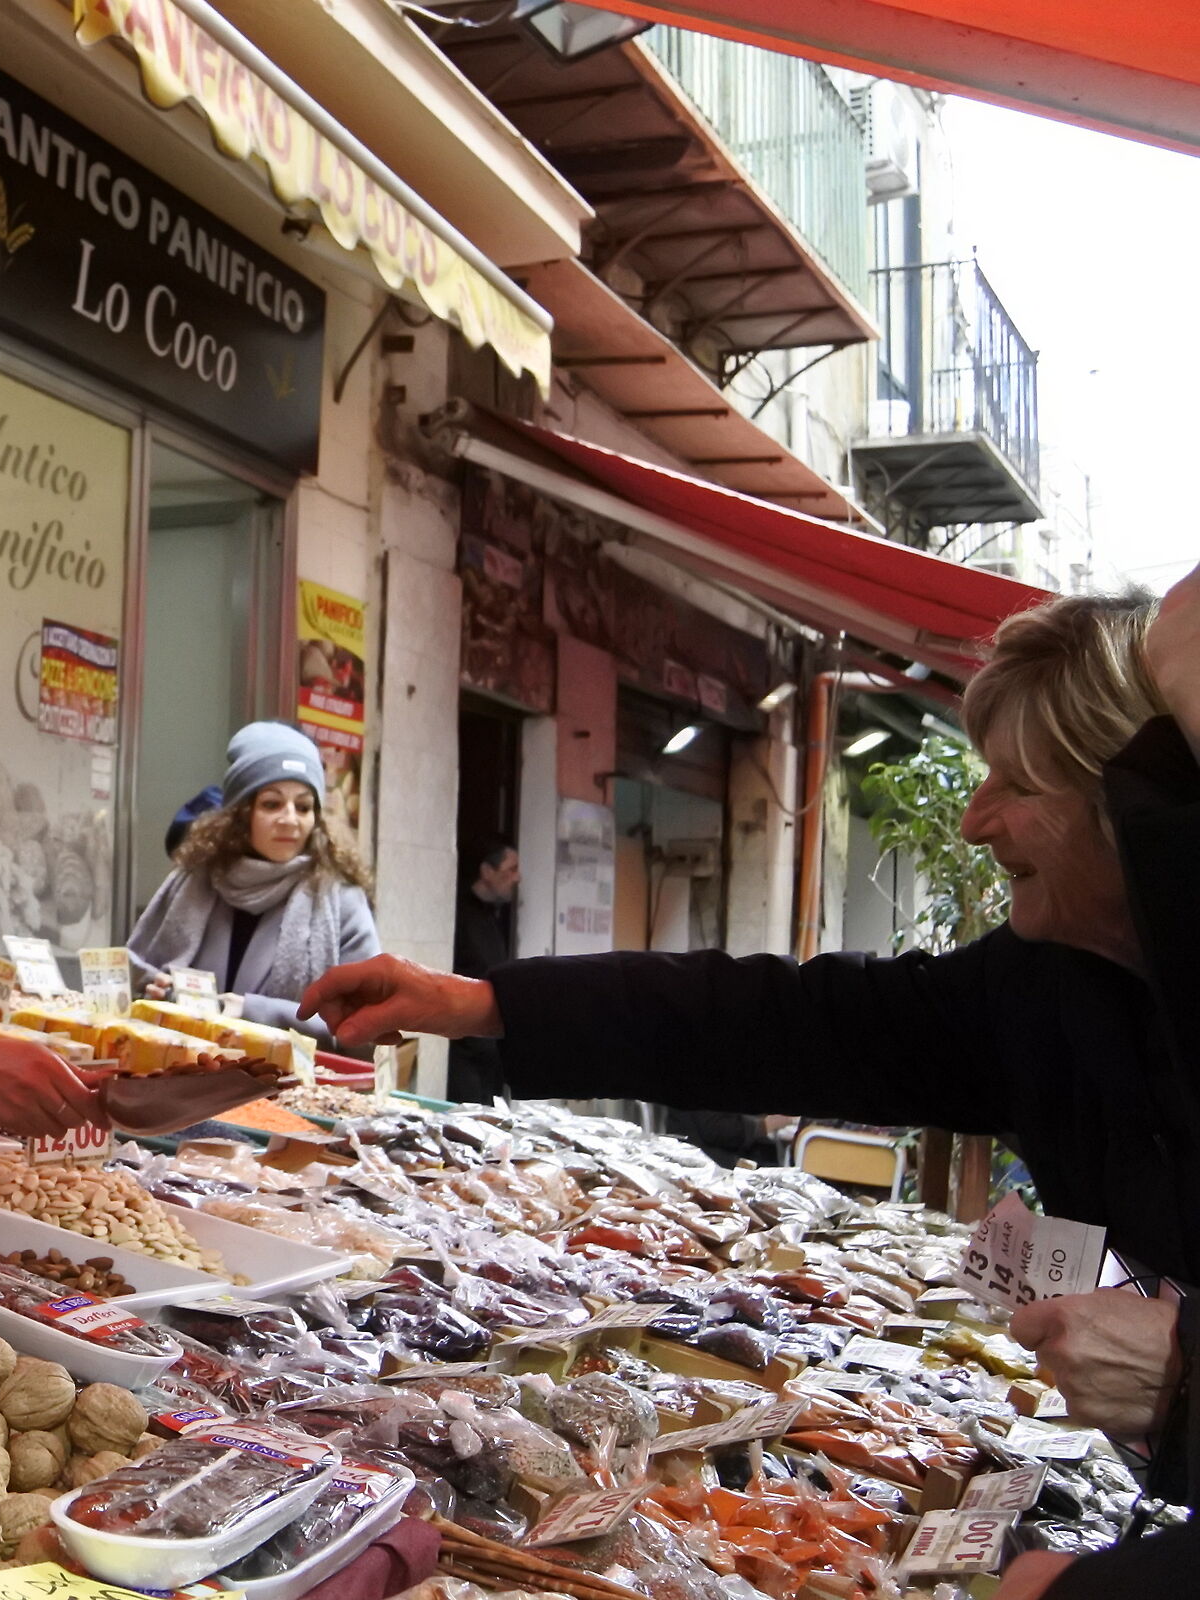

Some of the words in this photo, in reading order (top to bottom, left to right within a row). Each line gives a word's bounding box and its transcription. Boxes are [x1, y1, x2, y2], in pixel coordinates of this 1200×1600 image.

[149, 197, 305, 333] PANIFICIO
[1001, 1221, 1014, 1259] MAR
[963, 1249, 989, 1281] 13
[1019, 1240, 1035, 1275] MER
[1048, 1248, 1067, 1282] GIO
[988, 1263, 1015, 1295] 14
[1015, 1279, 1037, 1306] 15
[215, 1435, 258, 1451] DIEGO
[911, 1527, 938, 1557] PINOLI
[954, 1520, 999, 1561] 1,00
